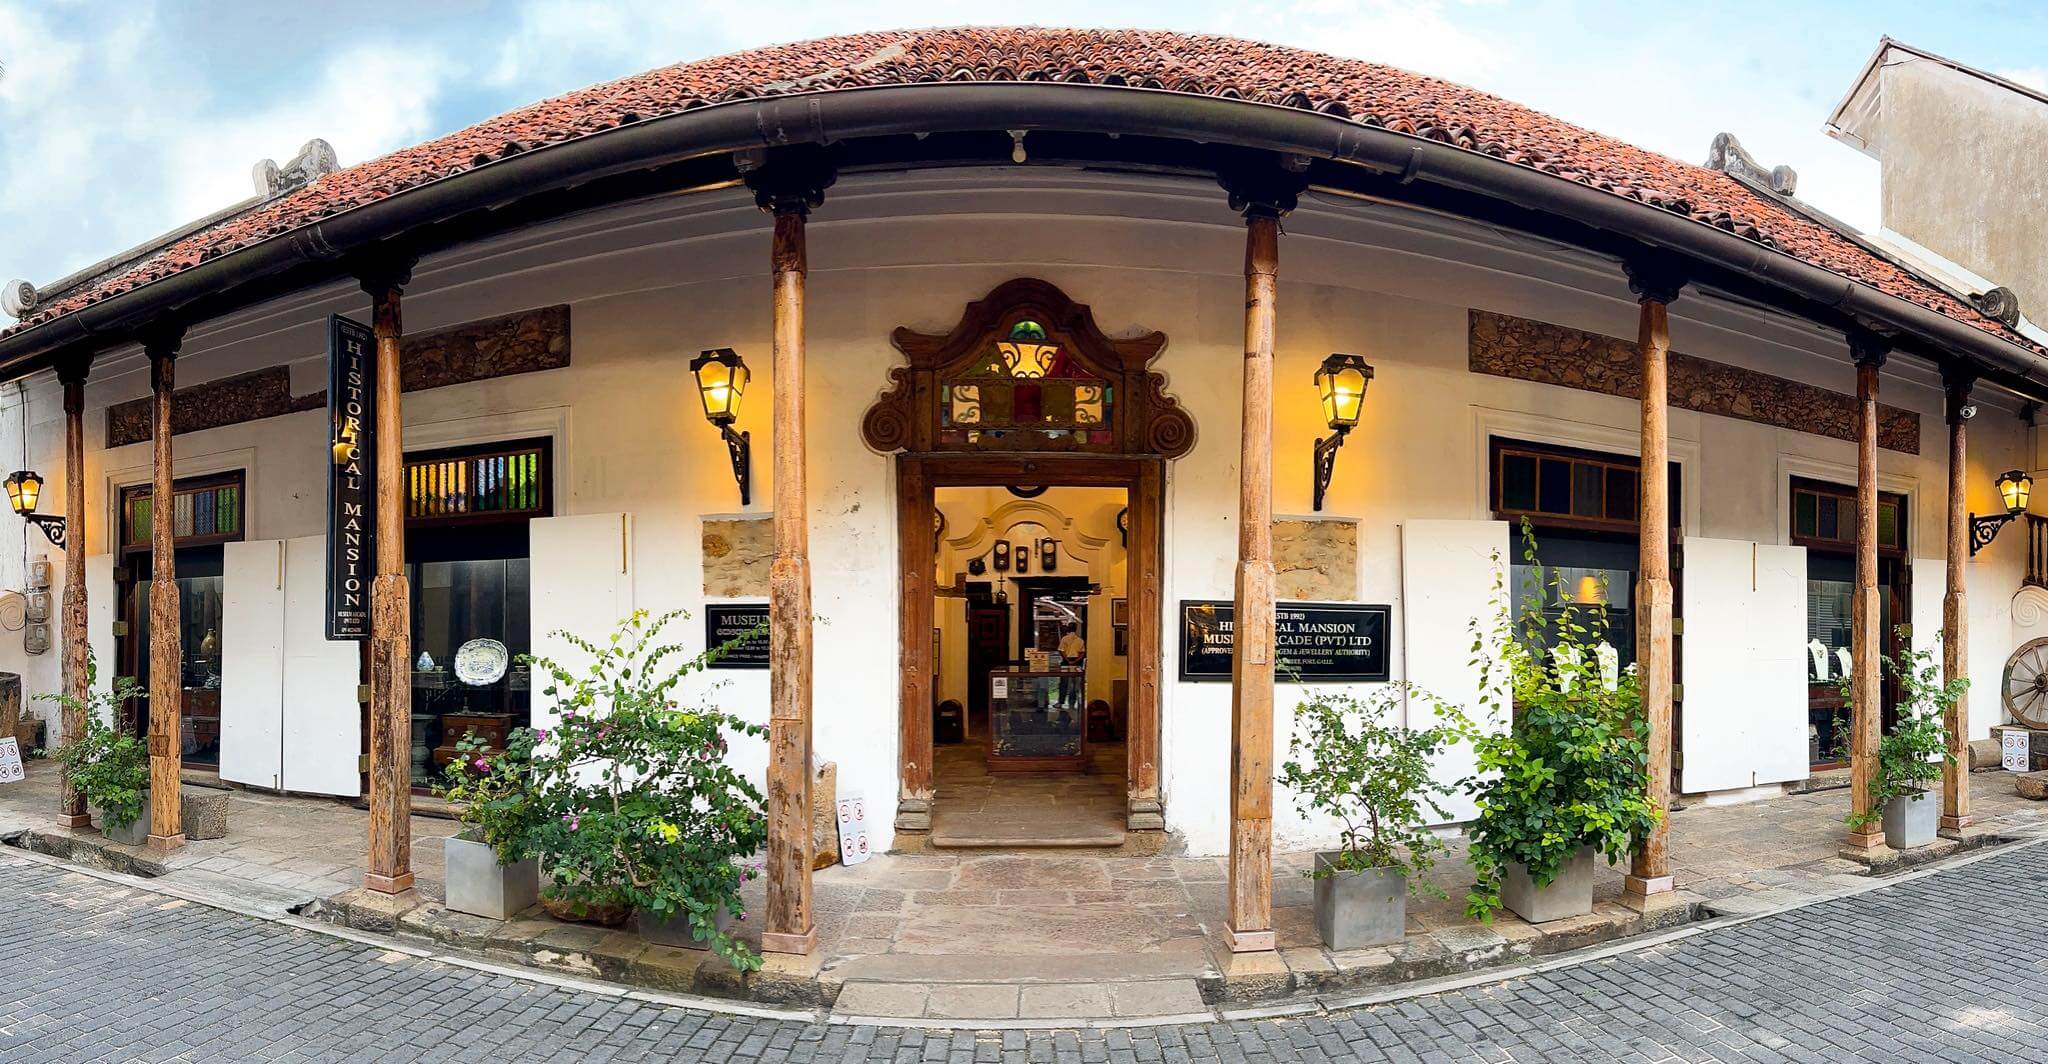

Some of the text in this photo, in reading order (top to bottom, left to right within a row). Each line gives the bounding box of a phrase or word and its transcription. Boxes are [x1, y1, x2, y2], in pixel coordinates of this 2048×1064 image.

[345, 339, 362, 490] HISTORICAL
[344, 502, 362, 606] MANSION
[1298, 623, 1356, 633] MANSION
[1315, 636, 1346, 647] (PVT)
[1349, 636, 1372, 646] LTD
[1201, 646, 1233, 655] (APPROVE
